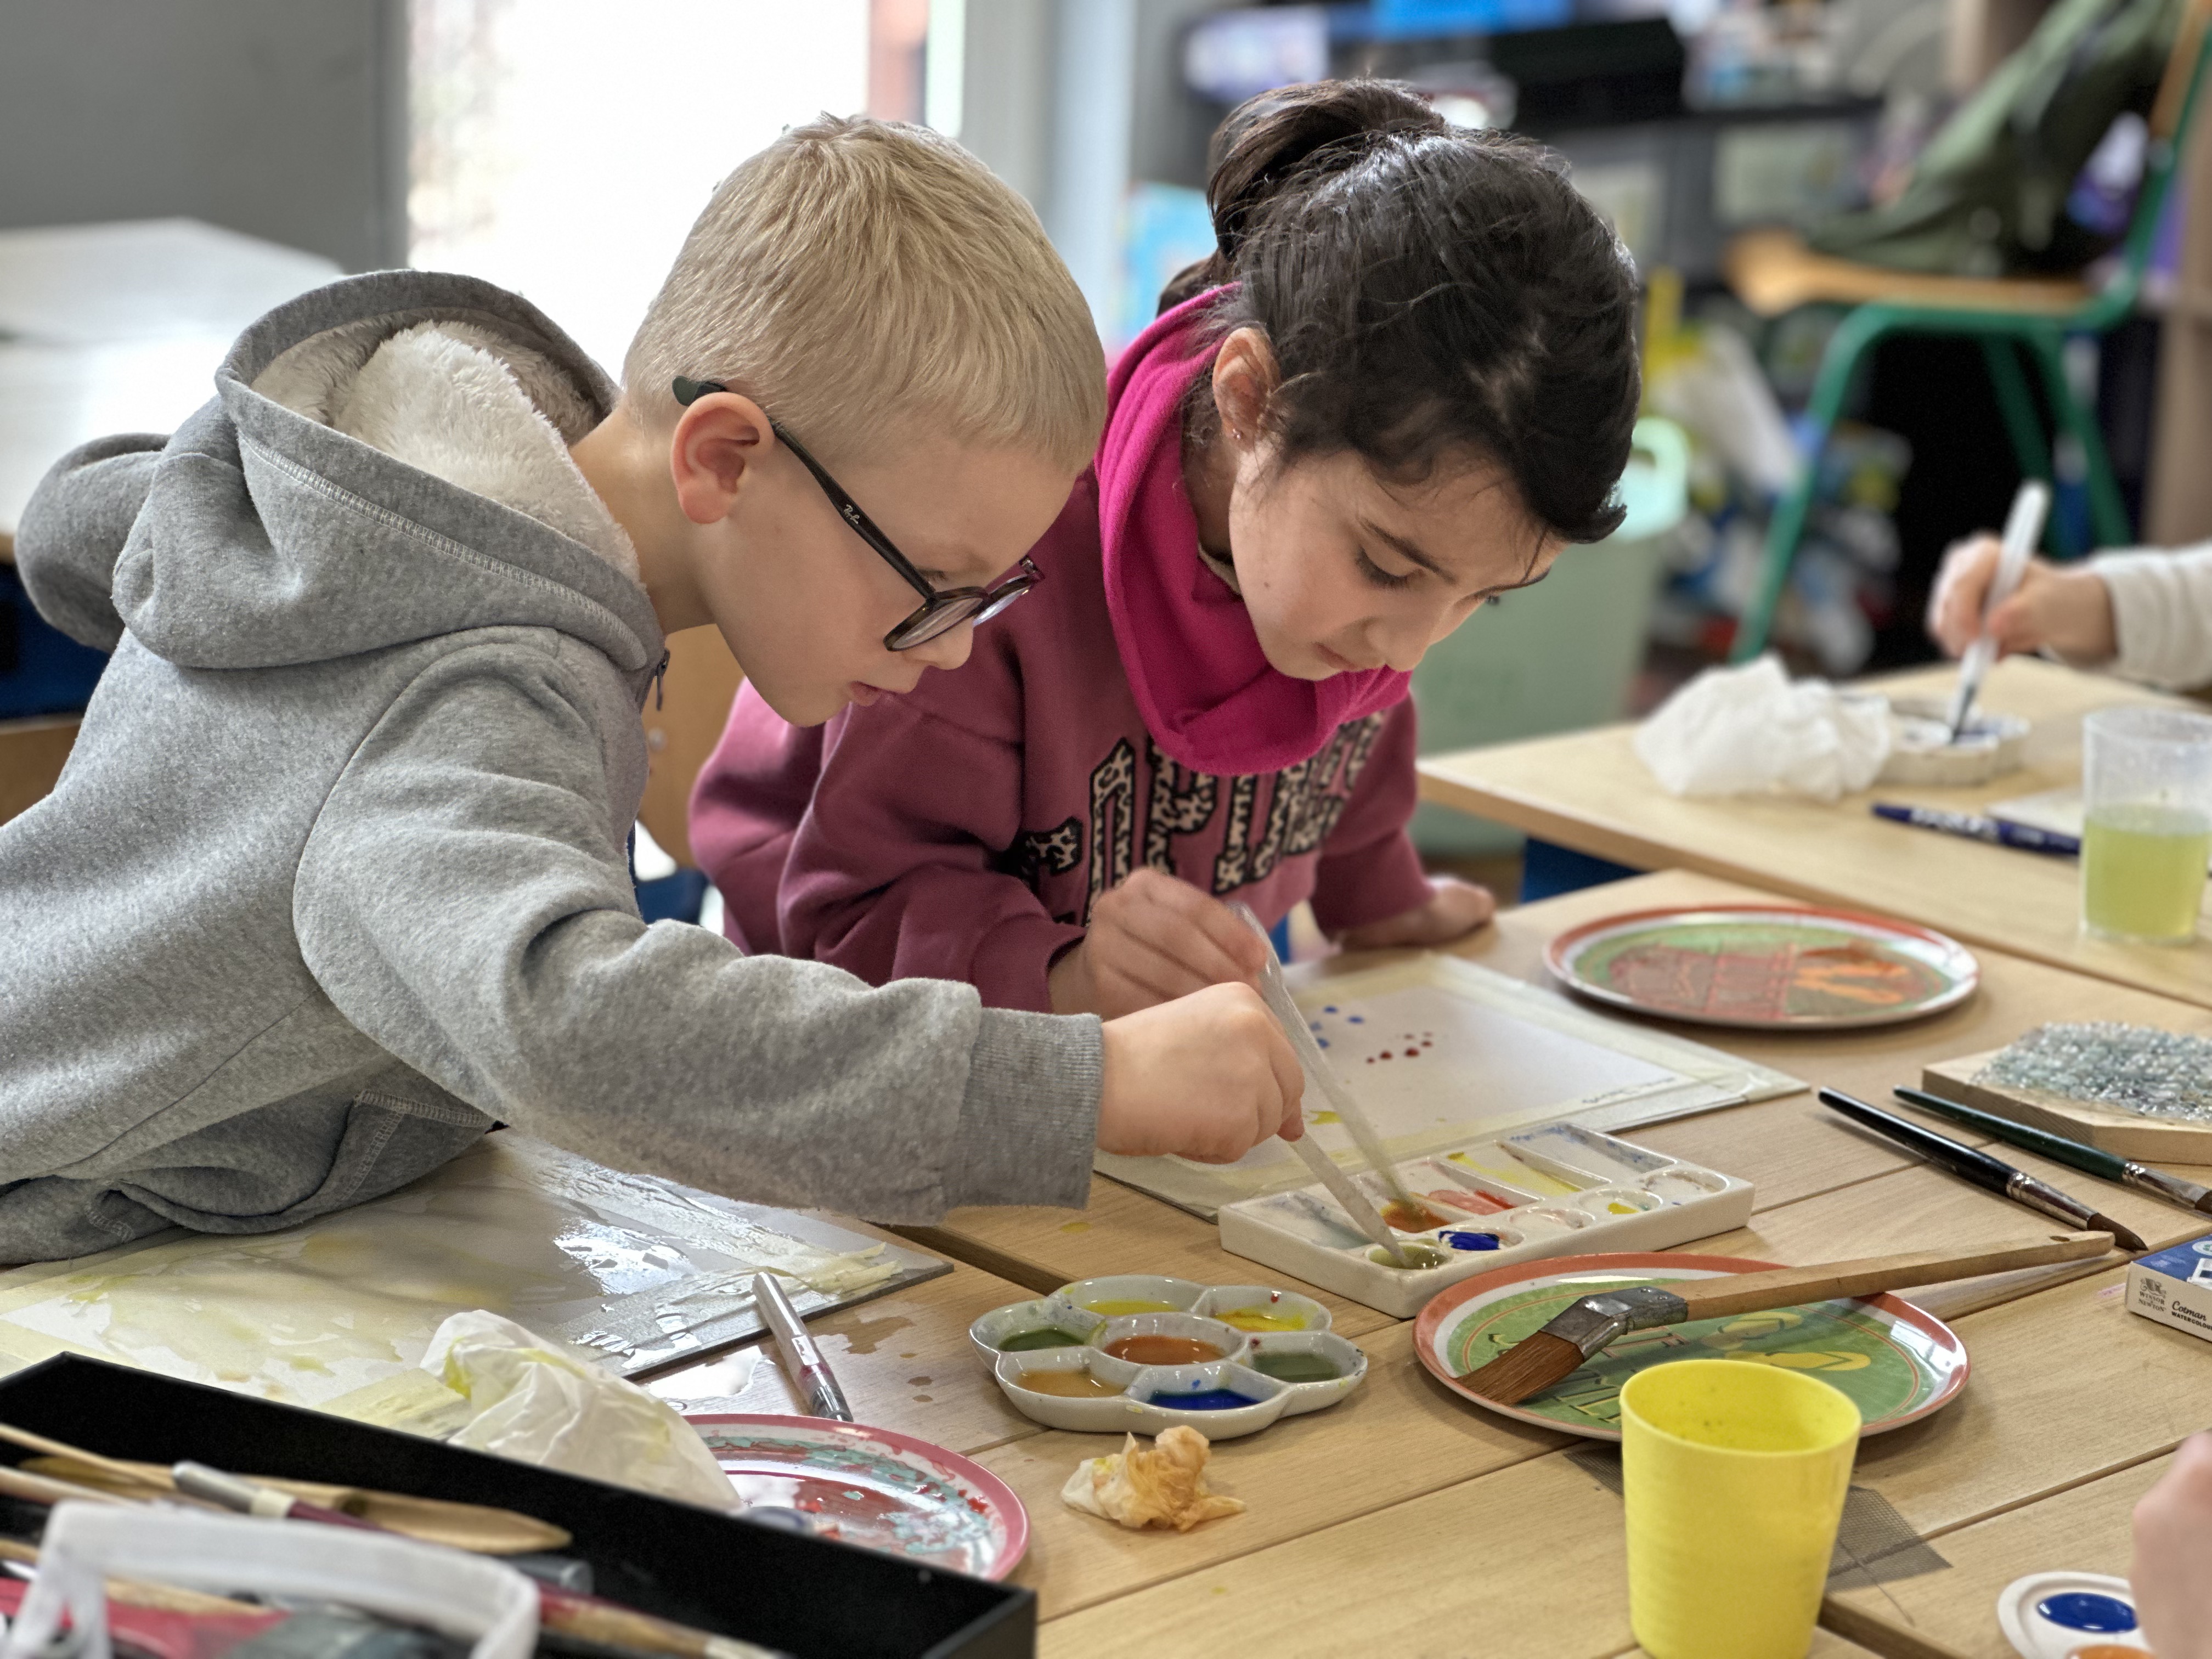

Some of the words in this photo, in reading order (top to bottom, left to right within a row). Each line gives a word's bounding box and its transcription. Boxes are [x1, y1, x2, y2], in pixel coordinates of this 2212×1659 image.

[2138, 1298, 2165, 1312] NEWTON
[2140, 1291, 2165, 1305] WINSOR
[2172, 1300, 2207, 1321] Cotman
